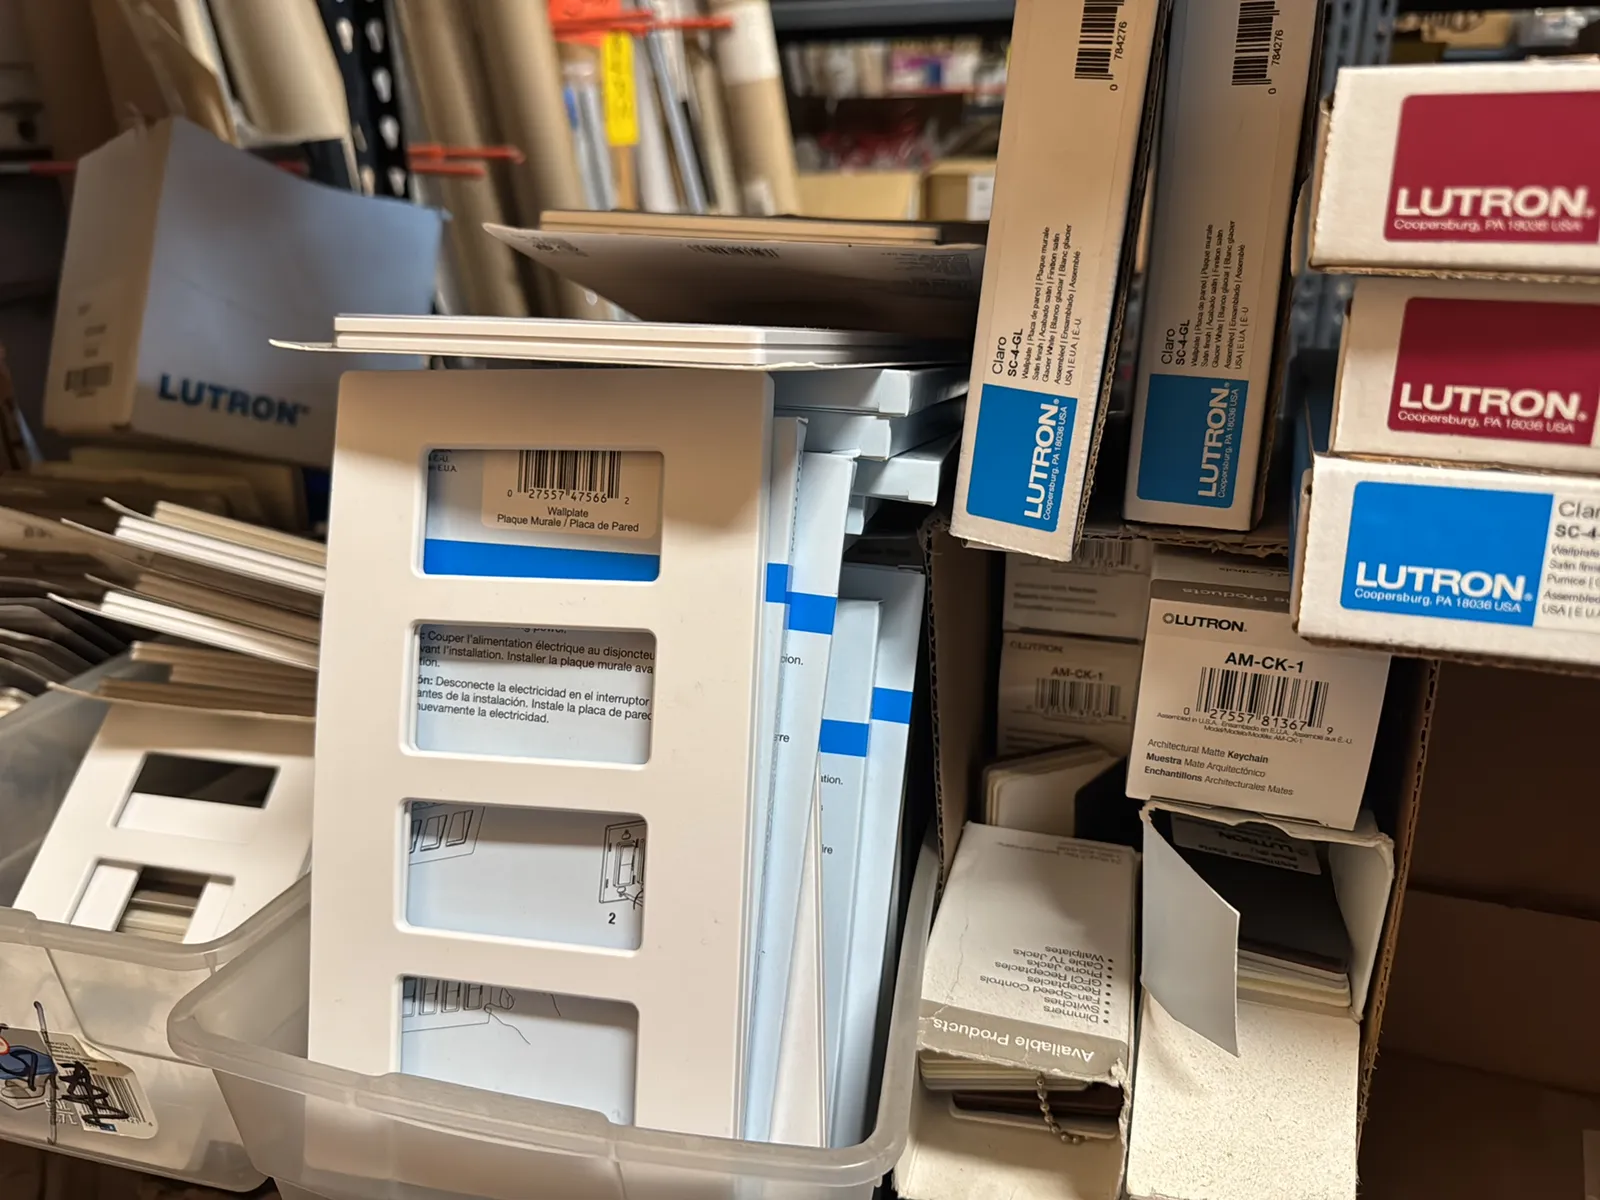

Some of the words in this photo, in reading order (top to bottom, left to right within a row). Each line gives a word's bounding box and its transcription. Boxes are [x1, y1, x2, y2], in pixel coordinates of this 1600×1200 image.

[1114, 21, 1128, 60] 784276
[1272, 29, 1284, 66] 784276
[1041, 226, 1050, 253] murale
[1036, 255, 1046, 281] Plaque
[1033, 286, 1041, 309] pared
[1030, 310, 1038, 320] de
[1027, 321, 1036, 341] Placa
[1161, 328, 1175, 364] Claro
[1175, 319, 1190, 365] SC-4-GL
[992, 336, 1006, 374] Claro
[1007, 328, 1023, 377] SC-4-GL
[1021, 347, 1032, 379] Wallplate
[1058, 406, 1067, 425] USA
[1054, 426, 1064, 450] 18036
[1051, 453, 1060, 465] PA
[528, 490, 565, 500] 27557
[571, 492, 608, 504] 47566
[624, 497, 629, 505] 2
[497, 513, 528, 525] Plaque
[530, 516, 561, 527] Murale
[569, 518, 594, 529] Placa
[597, 521, 609, 530] de
[611, 521, 639, 532] Pared
[548, 506, 588, 519] Wallplate
[428, 630, 464, 644] Couper
[466, 634, 532, 649] l'alimentation
[535, 640, 585, 655] électrique
[587, 647, 600, 655] au
[443, 645, 504, 660] l'installation.
[507, 651, 546, 664] Installer
[548, 655, 557, 664] la
[560, 656, 594, 670] plaque
[597, 661, 632, 672] murale
[1224, 652, 1303, 673] AM-CK-1
[435, 676, 494, 691] Desconecte
[497, 682, 506, 692] la
[508, 684, 566, 698] electricidad
[568, 691, 581, 699] en
[584, 691, 593, 700] el
[596, 691, 650, 707] interruptor
[417, 690, 442, 700] antes
[445, 690, 458, 701] de
[461, 691, 470, 702] la
[472, 692, 528, 708] instalación.
[531, 698, 564, 711] Instale
[567, 702, 575, 712] la
[578, 704, 606, 715] placa
[608, 707, 622, 717] de
[477, 706, 486, 717] la
[489, 708, 549, 723] electricidad.
[1183, 707, 1190, 715] 0
[1209, 709, 1254, 724] 27557
[1262, 716, 1307, 731] 81367
[1327, 726, 1334, 735] 9
[1147, 738, 1199, 753] Architectural
[1201, 746, 1225, 757] Matte
[1227, 750, 1268, 763] Keychain
[1146, 752, 1182, 765] Muestra
[1184, 758, 1205, 768] Mate
[1206, 762, 1266, 777] Arquitectónico
[1144, 765, 1202, 782] Enchantillons
[1204, 775, 1266, 791] Architecturales
[1267, 784, 1293, 795] Mates
[608, 912, 616, 924] 2
[1013, 949, 1047, 960] Jacks
[1044, 946, 1104, 962] Wallplates
[1049, 955, 1065, 964] TV
[1068, 958, 1103, 970] Cable
[994, 962, 1067, 981] Receptacles
[1026, 959, 1062, 971] Jacks
[1064, 962, 1102, 978] Phone
[980, 975, 1029, 991] Controls
[1027, 976, 1101, 996] Receptacles
[1070, 975, 1102, 987] GFCI
[1032, 986, 1100, 1005] Fan-Speed
[1044, 997, 1100, 1014] Switches
[1043, 1006, 1098, 1024] Dimmers
[933, 1017, 1009, 1045] Products
[1015, 1036, 1094, 1062] Available
